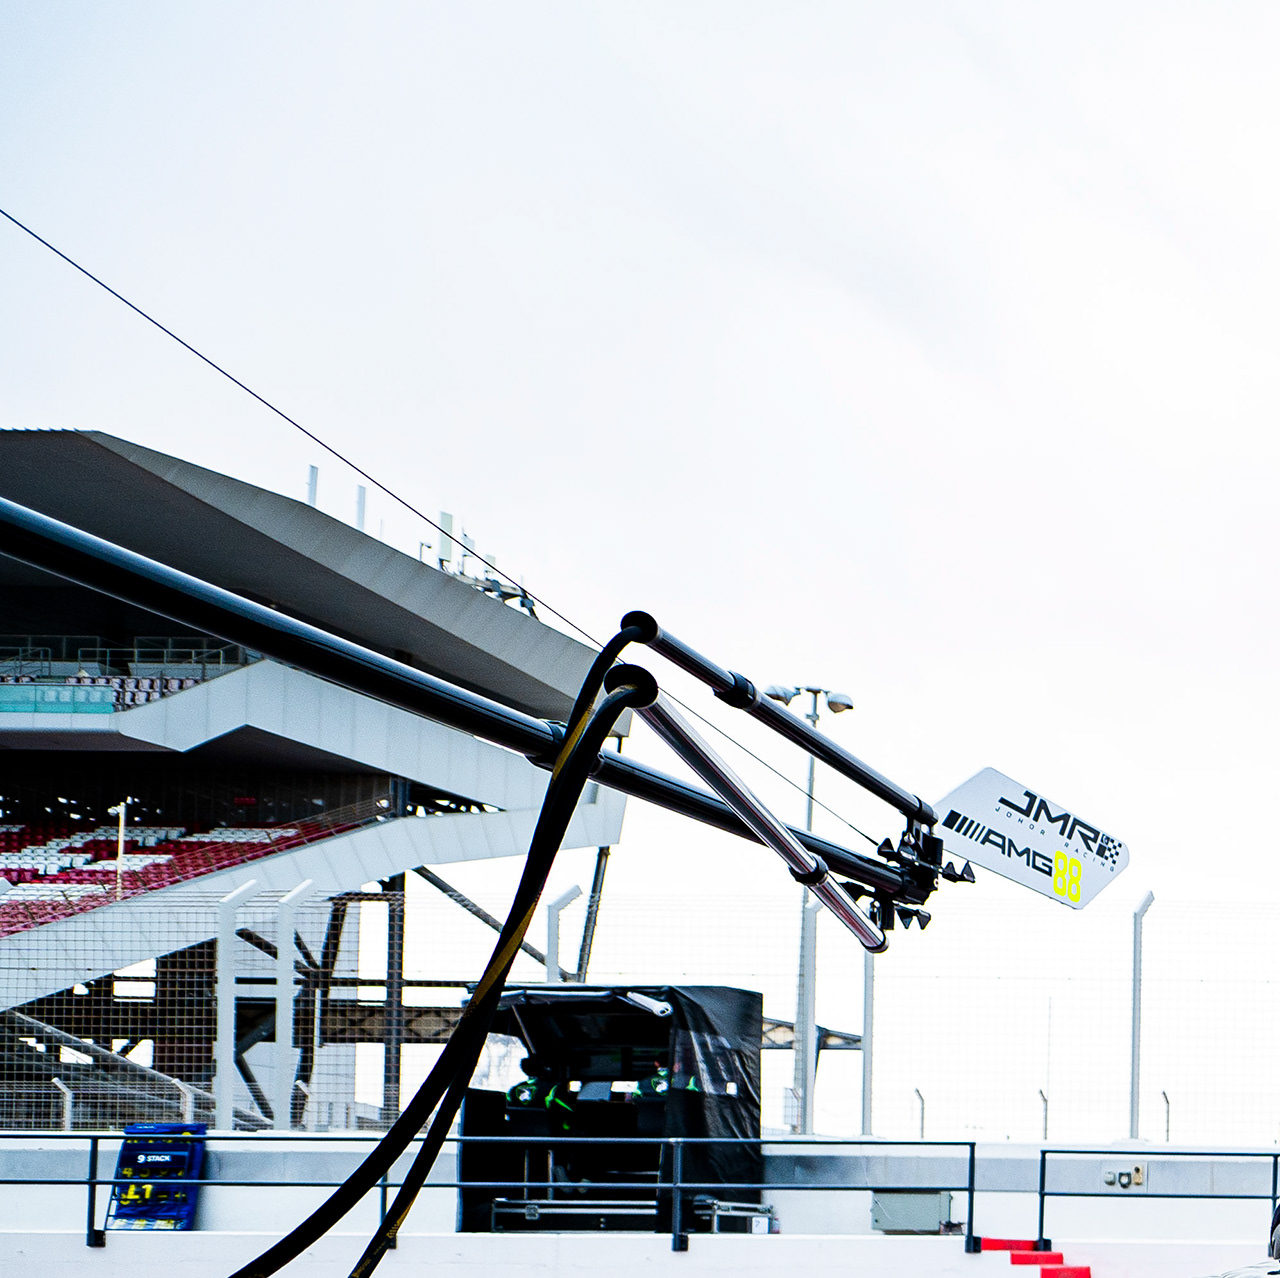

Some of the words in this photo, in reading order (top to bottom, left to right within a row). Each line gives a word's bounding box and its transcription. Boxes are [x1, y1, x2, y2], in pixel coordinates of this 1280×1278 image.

[995, 806, 1046, 836] JOHOR
[1063, 842, 1115, 872] RACING
[998, 790, 1101, 853] JMR
[1053, 850, 1082, 903] 88
